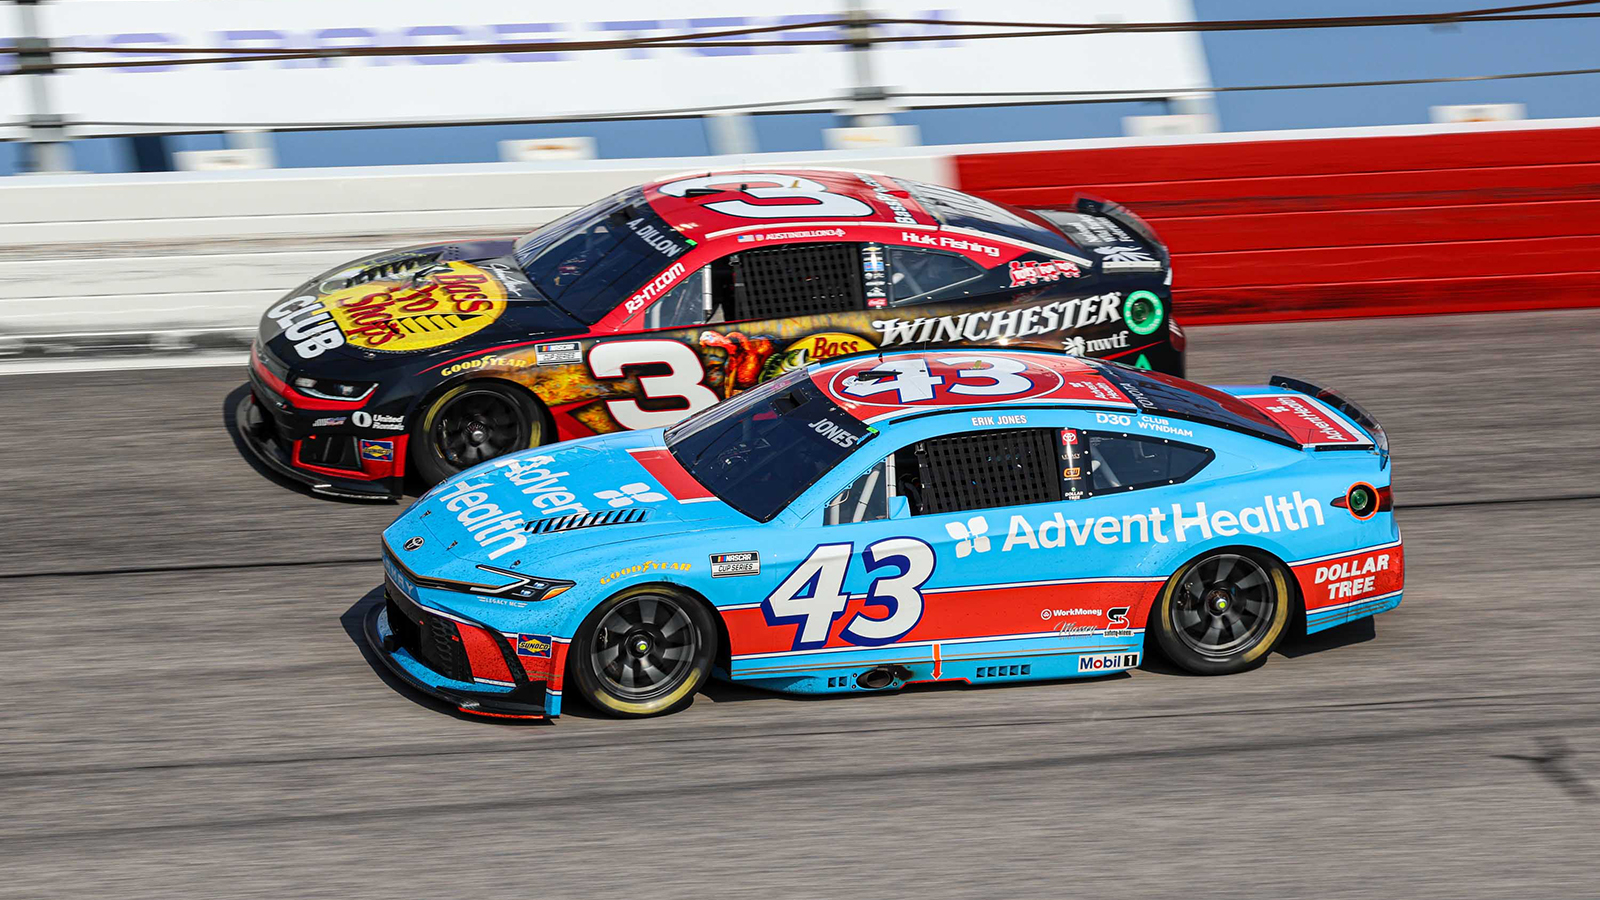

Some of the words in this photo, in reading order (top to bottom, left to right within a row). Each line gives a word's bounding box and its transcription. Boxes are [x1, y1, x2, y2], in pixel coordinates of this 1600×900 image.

[659, 174, 875, 218] 3
[626, 218, 645, 230] A.
[635, 225, 682, 257] DILLON
[902, 232, 938, 246] Huk
[940, 236, 1000, 257] Fishing
[433, 273, 494, 313] Bass
[267, 295, 345, 359] CLUB
[339, 292, 406, 346] Shops
[872, 291, 1122, 347] WINCHESTER
[811, 336, 860, 360] Bass
[1086, 330, 1131, 352] nwtf
[441, 355, 527, 376] GOODYEAR
[588, 339, 721, 430] 3
[842, 356, 1035, 403] 43
[372, 422, 404, 431] Rentals
[373, 414, 404, 423] United
[971, 416, 994, 426] ERIK
[997, 415, 1027, 425] JONES
[1137, 421, 1194, 437] WYNDHAM
[1141, 416, 1169, 426] CLUB
[1276, 396, 1349, 442] AdventHealth
[808, 418, 859, 448] JONES
[430, 473, 528, 561] Health
[1001, 491, 1325, 552] AdventHealth
[726, 554, 752, 562] NASCAR
[731, 563, 754, 571] SERIES
[1315, 554, 1390, 585] DOLLAR
[600, 560, 692, 585] GOODYEAR
[760, 536, 937, 651] 43
[1328, 576, 1376, 600] TREE
[1053, 608, 1102, 617] WorkMoney
[519, 642, 549, 651] SUNOCO
[1080, 655, 1121, 670] Mobil
[1127, 655, 1134, 666] 1
